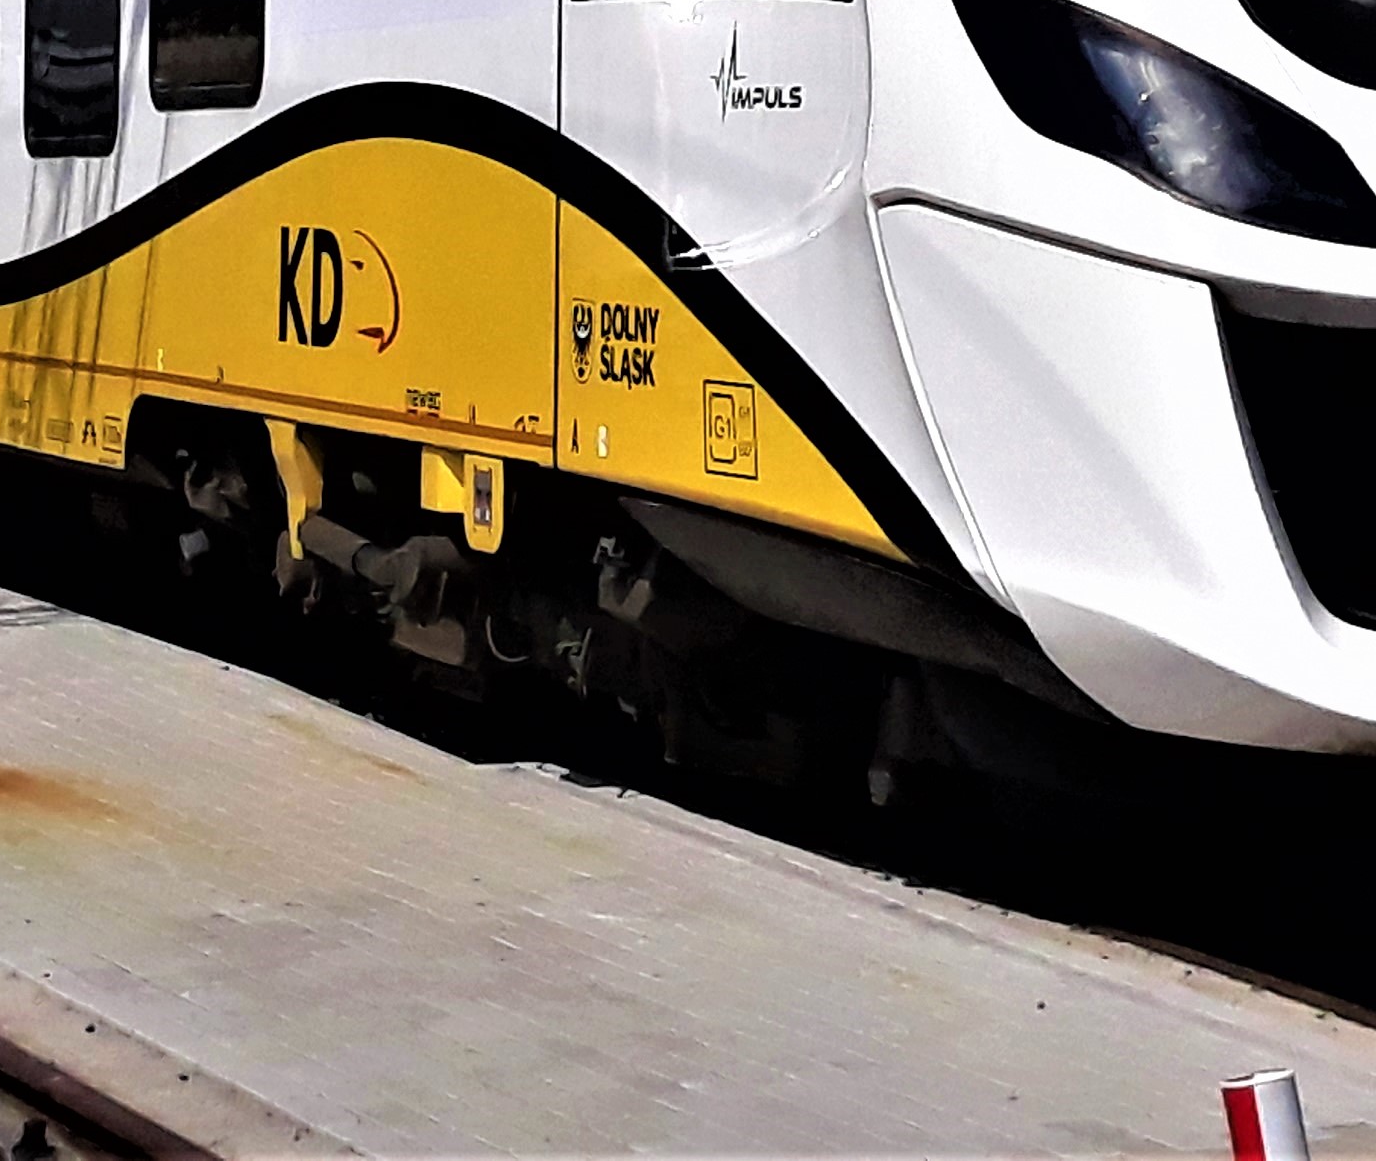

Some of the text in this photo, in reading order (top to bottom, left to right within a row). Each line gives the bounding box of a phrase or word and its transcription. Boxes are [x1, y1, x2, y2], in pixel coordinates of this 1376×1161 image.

[731, 86, 802, 109] IMPULS
[278, 225, 344, 348] KD
[600, 303, 659, 345] DOLNY
[599, 337, 656, 390] ŚLĄSK
